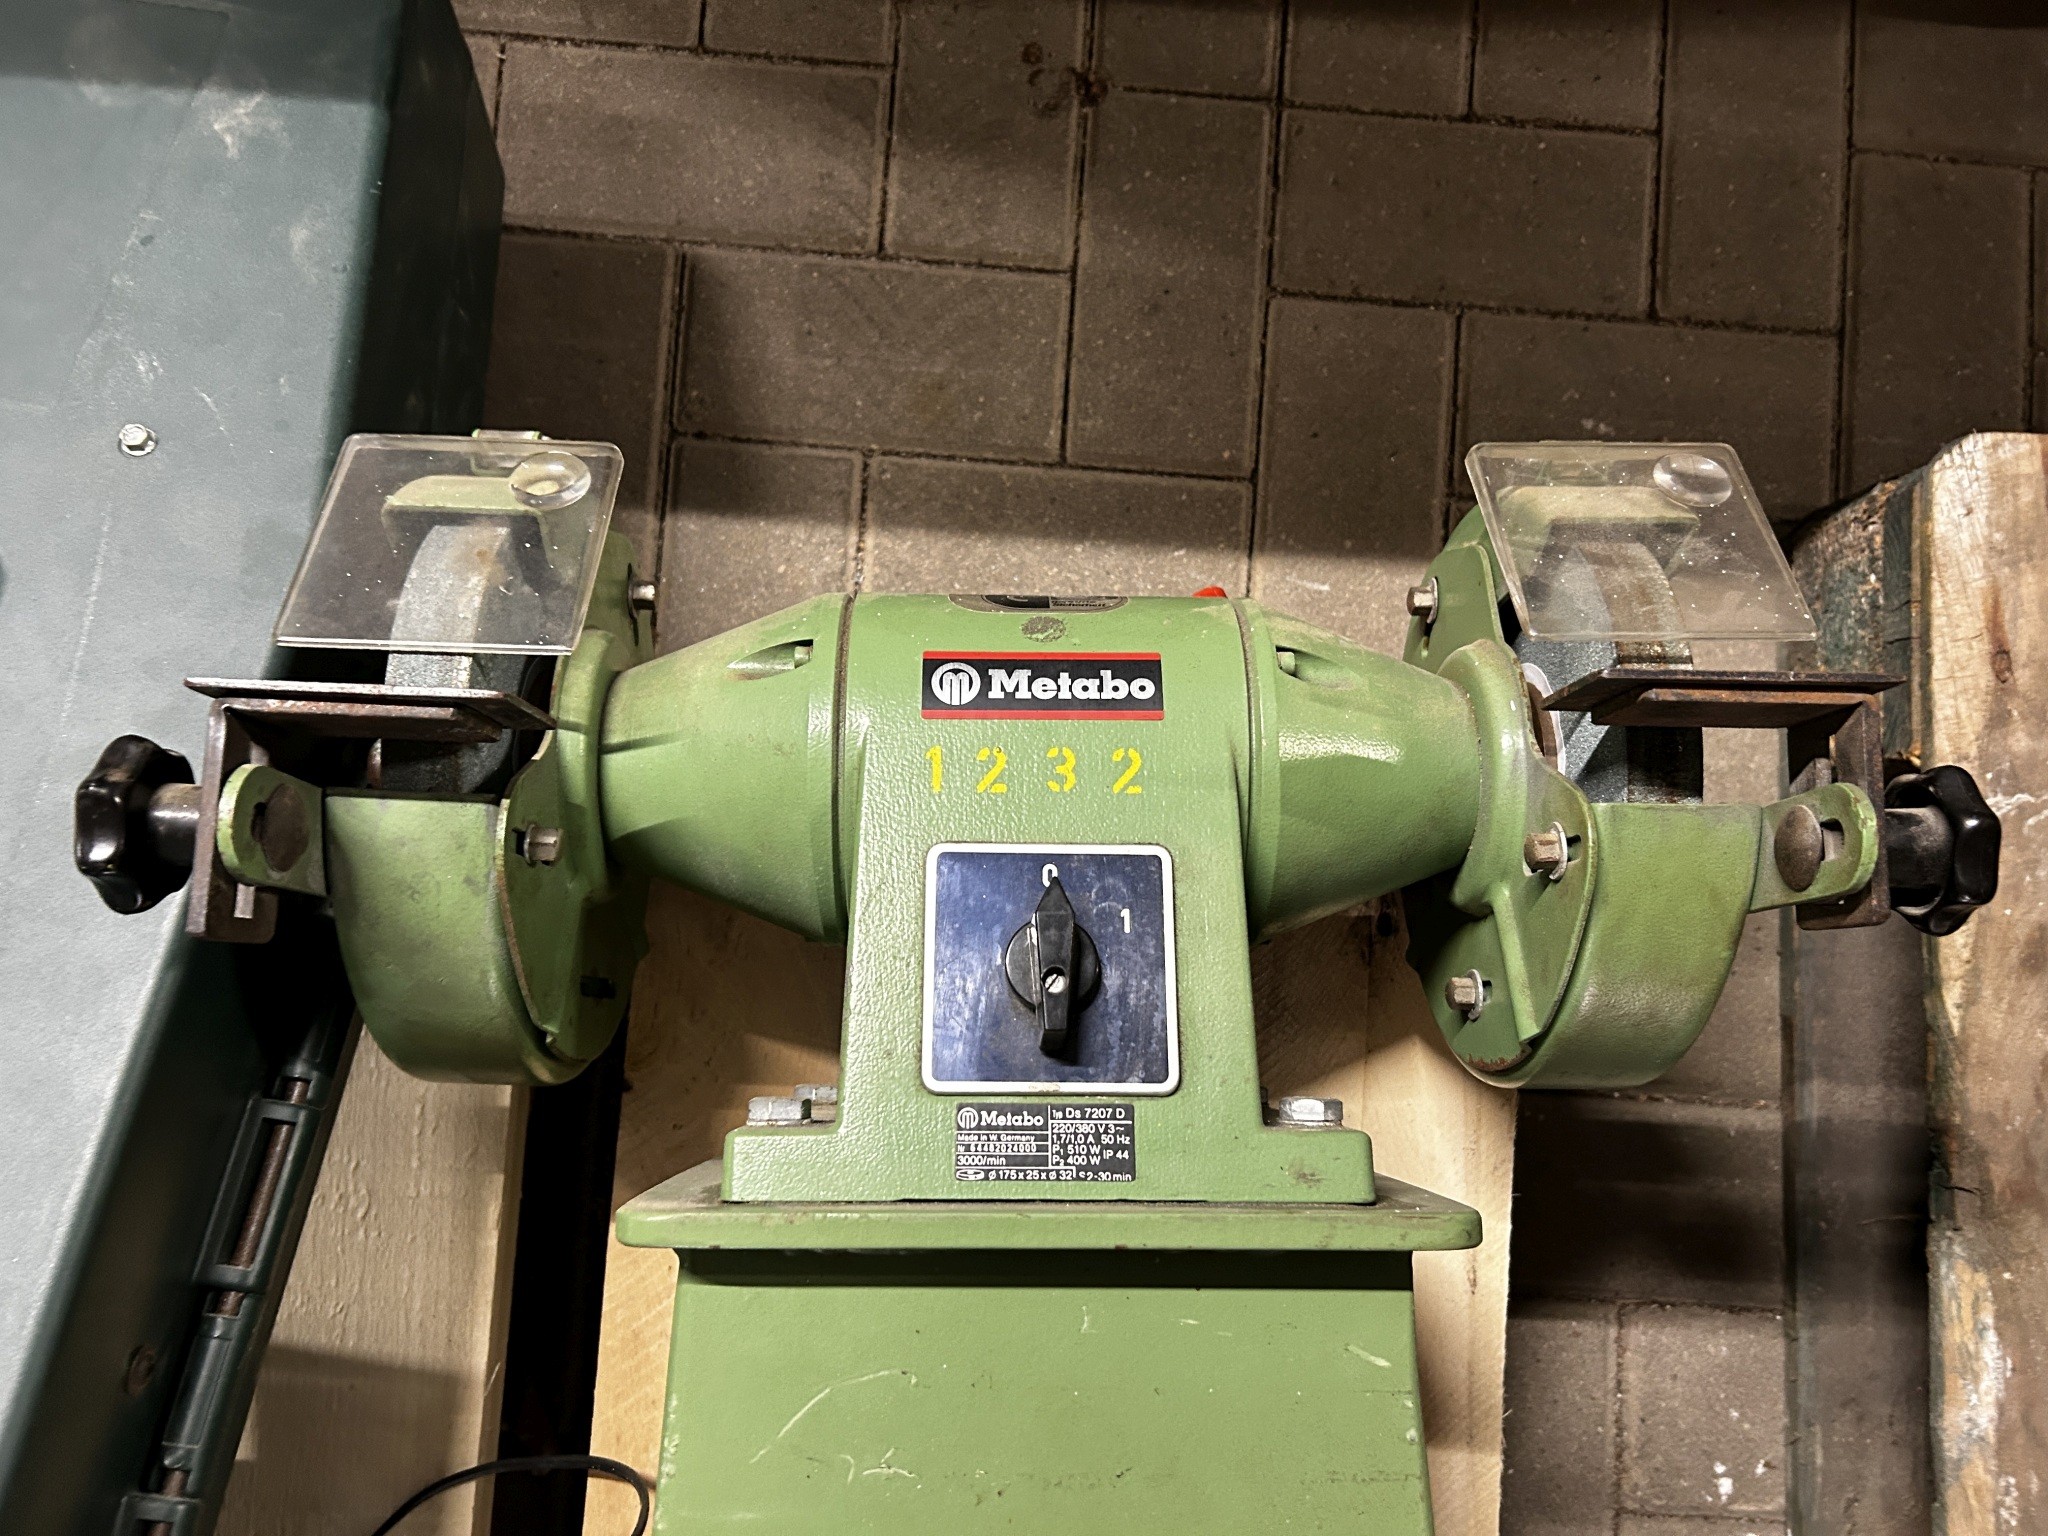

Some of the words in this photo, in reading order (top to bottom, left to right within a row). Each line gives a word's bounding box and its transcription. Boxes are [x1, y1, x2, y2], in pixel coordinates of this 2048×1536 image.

[988, 668, 1156, 700] Metabo
[1120, 908, 1131, 933] 1
[980, 1110, 1044, 1126] Metabo
[1066, 1107, 1082, 1119] Ds
[1084, 1108, 1113, 1119] 7207
[1115, 1108, 1126, 1119] D
[1052, 1123, 1096, 1134] 220/380
[1097, 1123, 1106, 1134] V
[1000, 1134, 1035, 1143] Germany
[1052, 1134, 1085, 1145] 1,7/1,0
[1087, 1134, 1096, 1144] A
[1100, 1134, 1115, 1144] 50
[1116, 1134, 1131, 1144] Hz
[1067, 1144, 1088, 1155] 510
[1089, 1144, 1101, 1154] W
[1103, 1149, 1114, 1160] IP
[1115, 1149, 1130, 1160] 44
[957, 1155, 1007, 1166] 3000/min
[1066, 1155, 1088, 1166] 400
[1089, 1155, 1101, 1166] W
